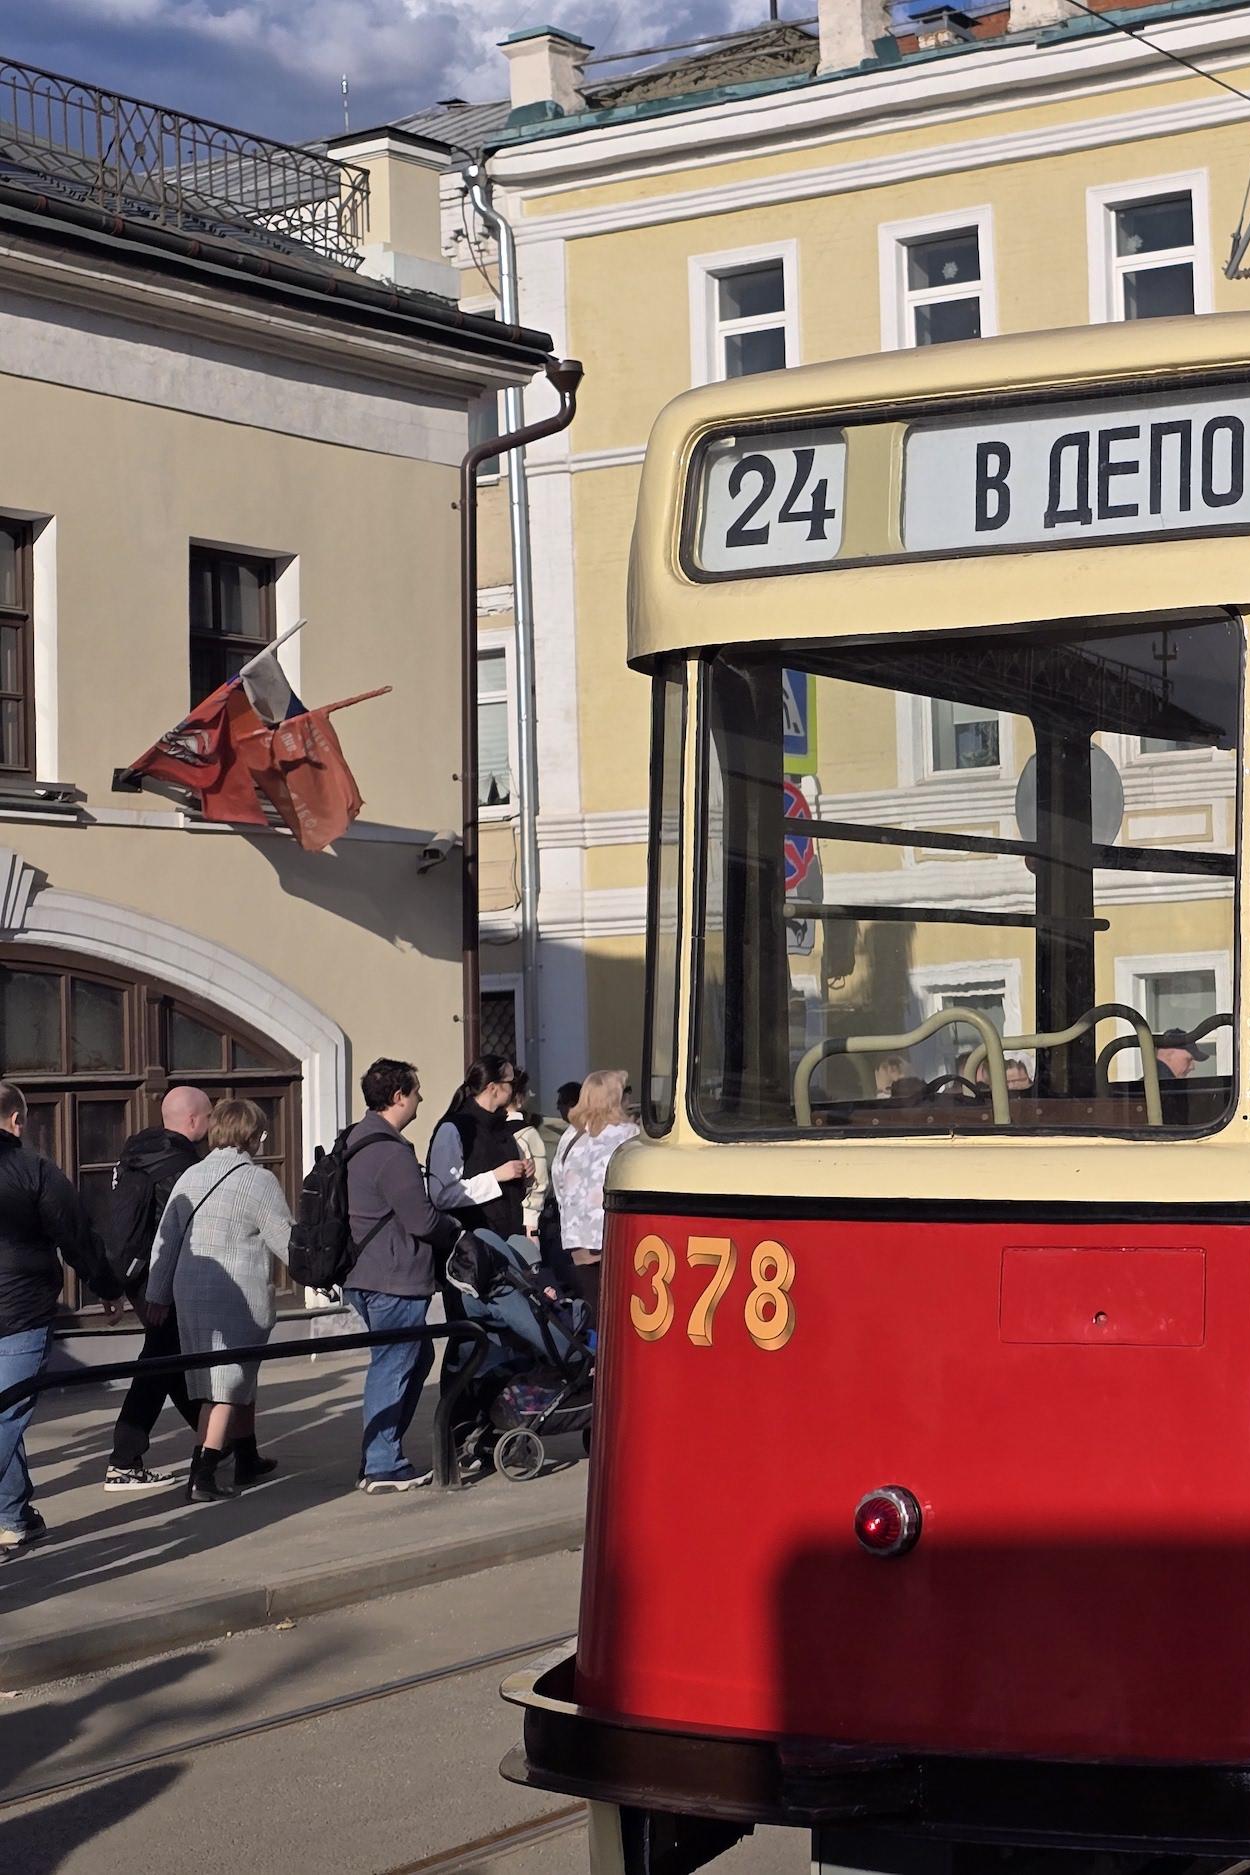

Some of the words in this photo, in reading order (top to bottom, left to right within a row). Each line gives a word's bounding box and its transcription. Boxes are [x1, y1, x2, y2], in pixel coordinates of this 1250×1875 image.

[725, 448, 836, 549] 24
[975, 441, 1012, 532] В
[1043, 415, 1245, 529] ДЕПО
[630, 1234, 796, 1351] 378
